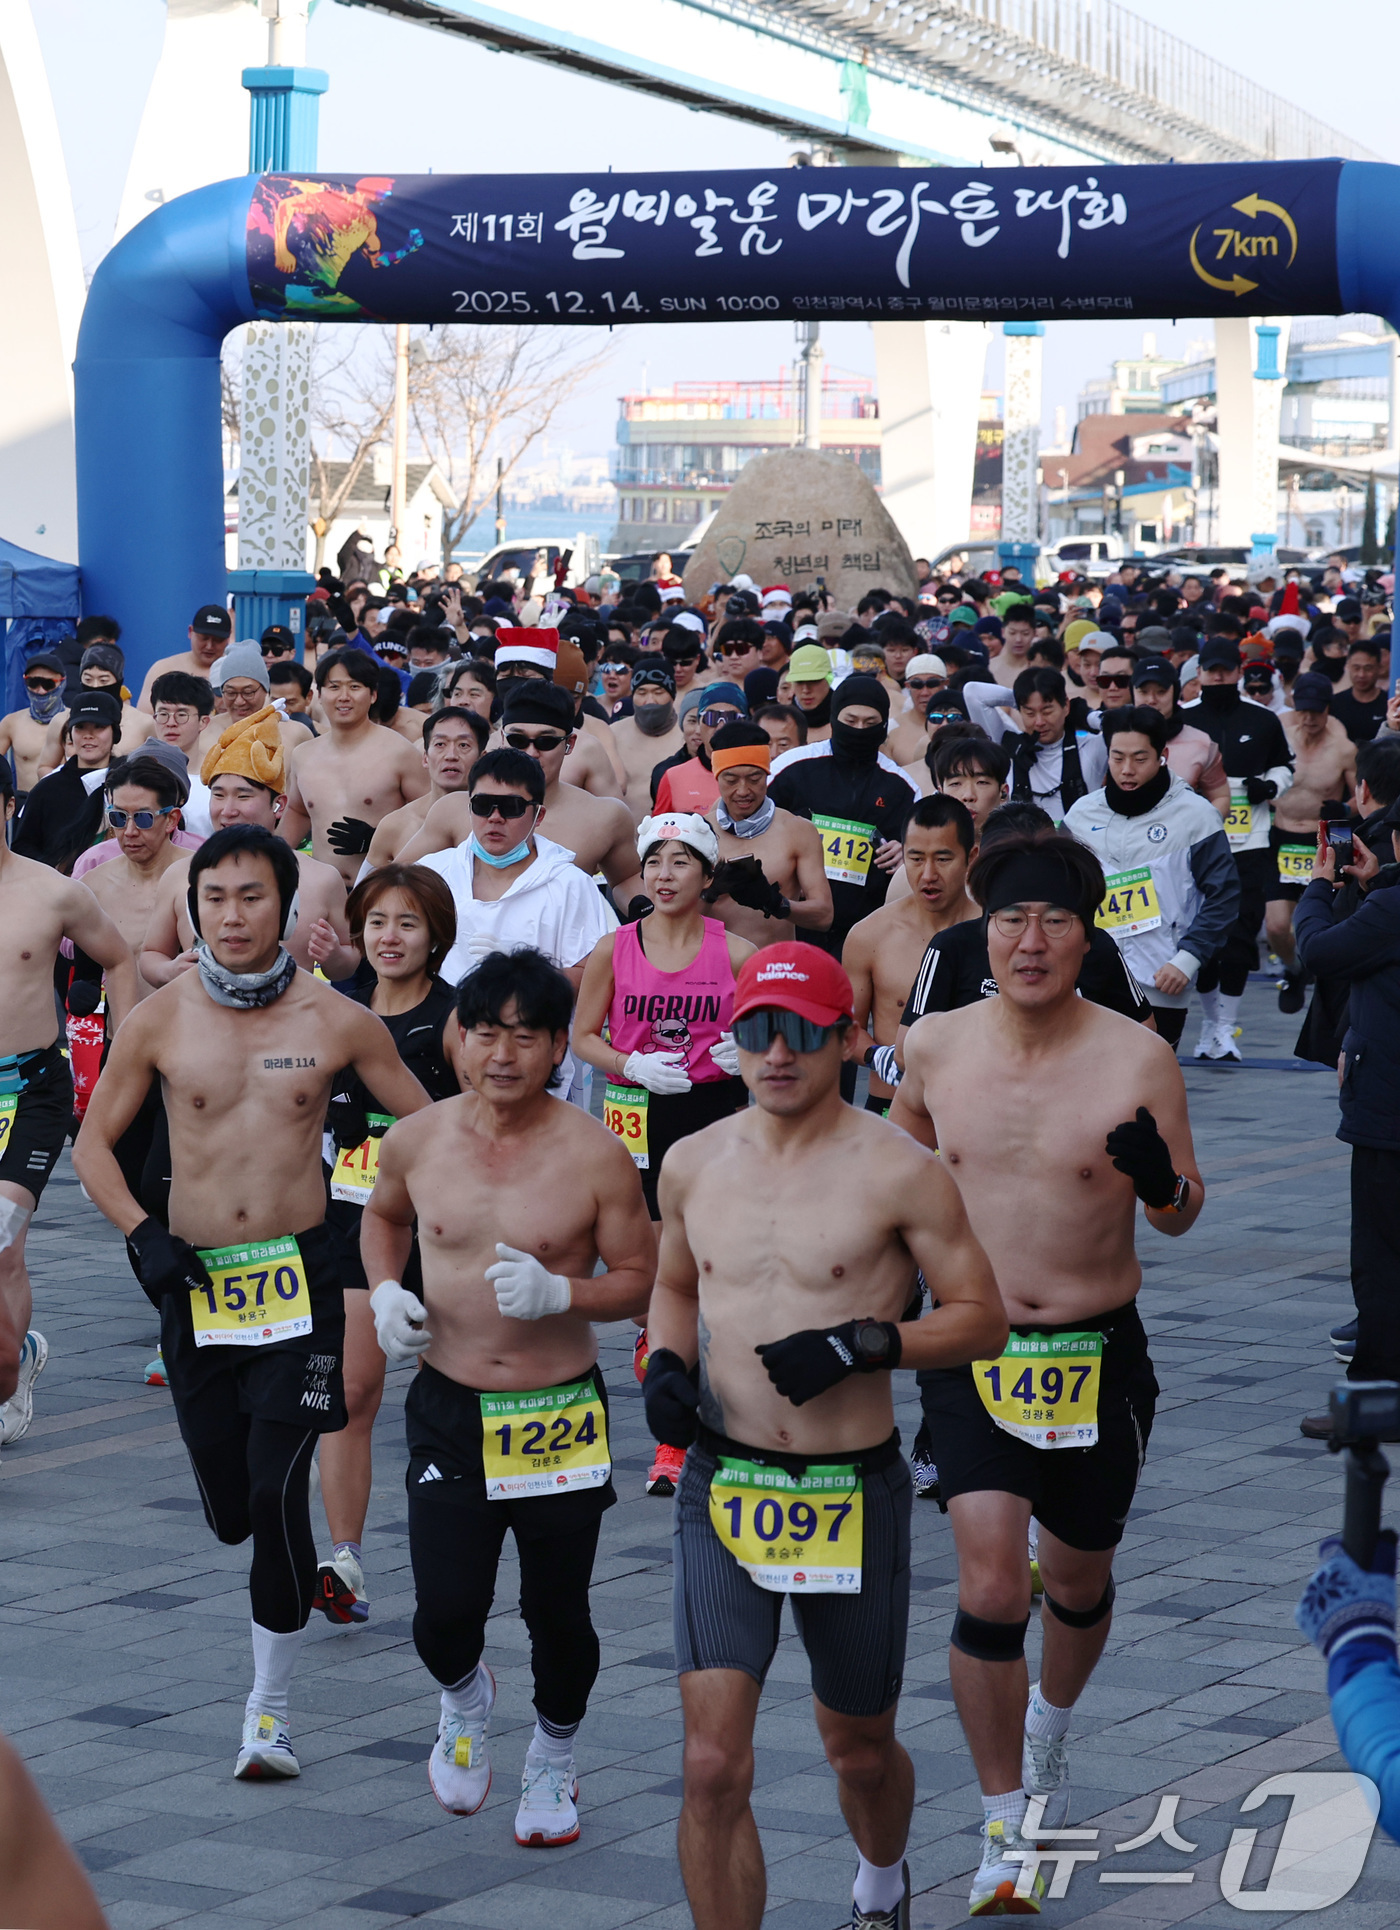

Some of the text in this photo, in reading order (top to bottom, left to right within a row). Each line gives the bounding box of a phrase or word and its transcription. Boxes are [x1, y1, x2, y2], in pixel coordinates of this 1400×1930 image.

[450, 212, 543, 243] 제11회
[797, 182, 1000, 289] 마라톤
[1213, 228, 1279, 260] 7km
[660, 297, 707, 311] SUN
[716, 295, 780, 311] 10:00
[792, 296, 882, 310] 인천광역시
[887, 296, 921, 310] 중구
[1059, 295, 1133, 310] 수변무대
[755, 518, 862, 541] 조국의 미래
[773, 551, 881, 577] 청년의 책임
[631, 669, 675, 692] OCK
[766, 962, 796, 972] new
[624, 994, 721, 1023] PIGRUN
[264, 1057, 316, 1070] 마라톤 114
[341, 1140, 380, 1170] 21
[361, 1174, 376, 1184] 박성
[251, 1242, 294, 1259] 마라톤대회
[199, 1266, 299, 1314] 1570
[238, 1309, 267, 1323] 황용구
[293, 1320, 308, 1330] 중구
[1011, 1341, 1097, 1353] 월미알몸 마라톤대회
[984, 1366, 1092, 1405] 1497
[300, 1390, 331, 1411] NIKE
[486, 1401, 515, 1412] 제11회
[1022, 1409, 1055, 1420] 정광용
[495, 1411, 598, 1456] 1224
[1077, 1429, 1093, 1439] 중구
[532, 1455, 562, 1468] 김문호
[591, 1469, 607, 1480] 중구
[801, 1475, 856, 1489] 마라톤대회
[723, 1496, 853, 1543] 1097
[765, 1548, 804, 1559] 홍승우
[836, 1573, 855, 1585] 중구
